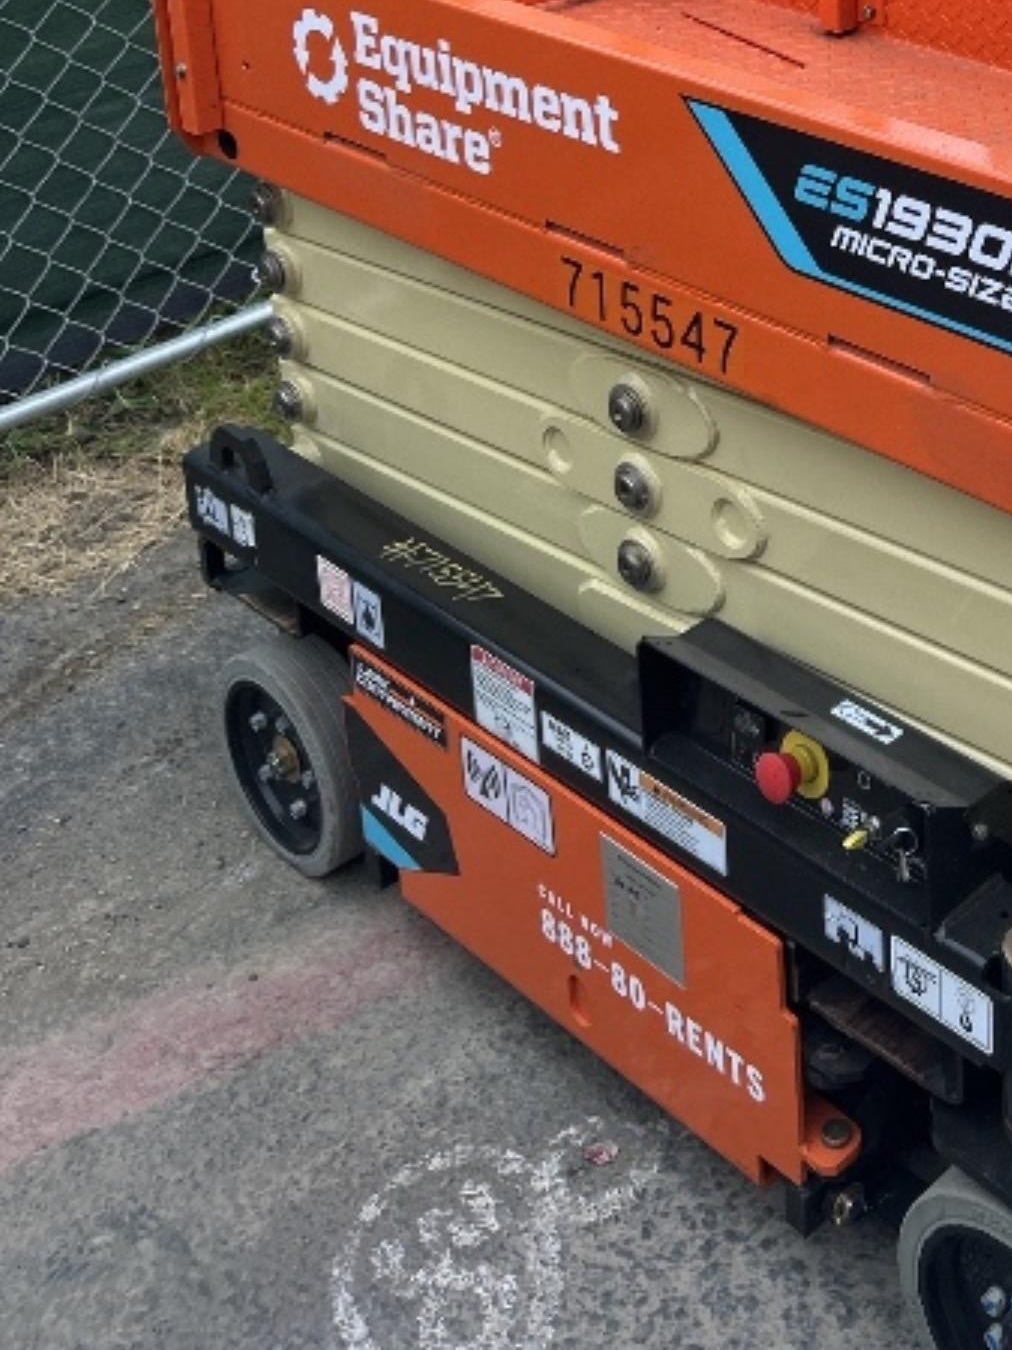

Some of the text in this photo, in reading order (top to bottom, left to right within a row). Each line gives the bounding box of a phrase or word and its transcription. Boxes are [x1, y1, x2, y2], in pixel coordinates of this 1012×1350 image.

[350, 10, 622, 153] Equipment
[560, 254, 739, 376] 715547
[541, 907, 766, 1102] 888-80-RENTS
